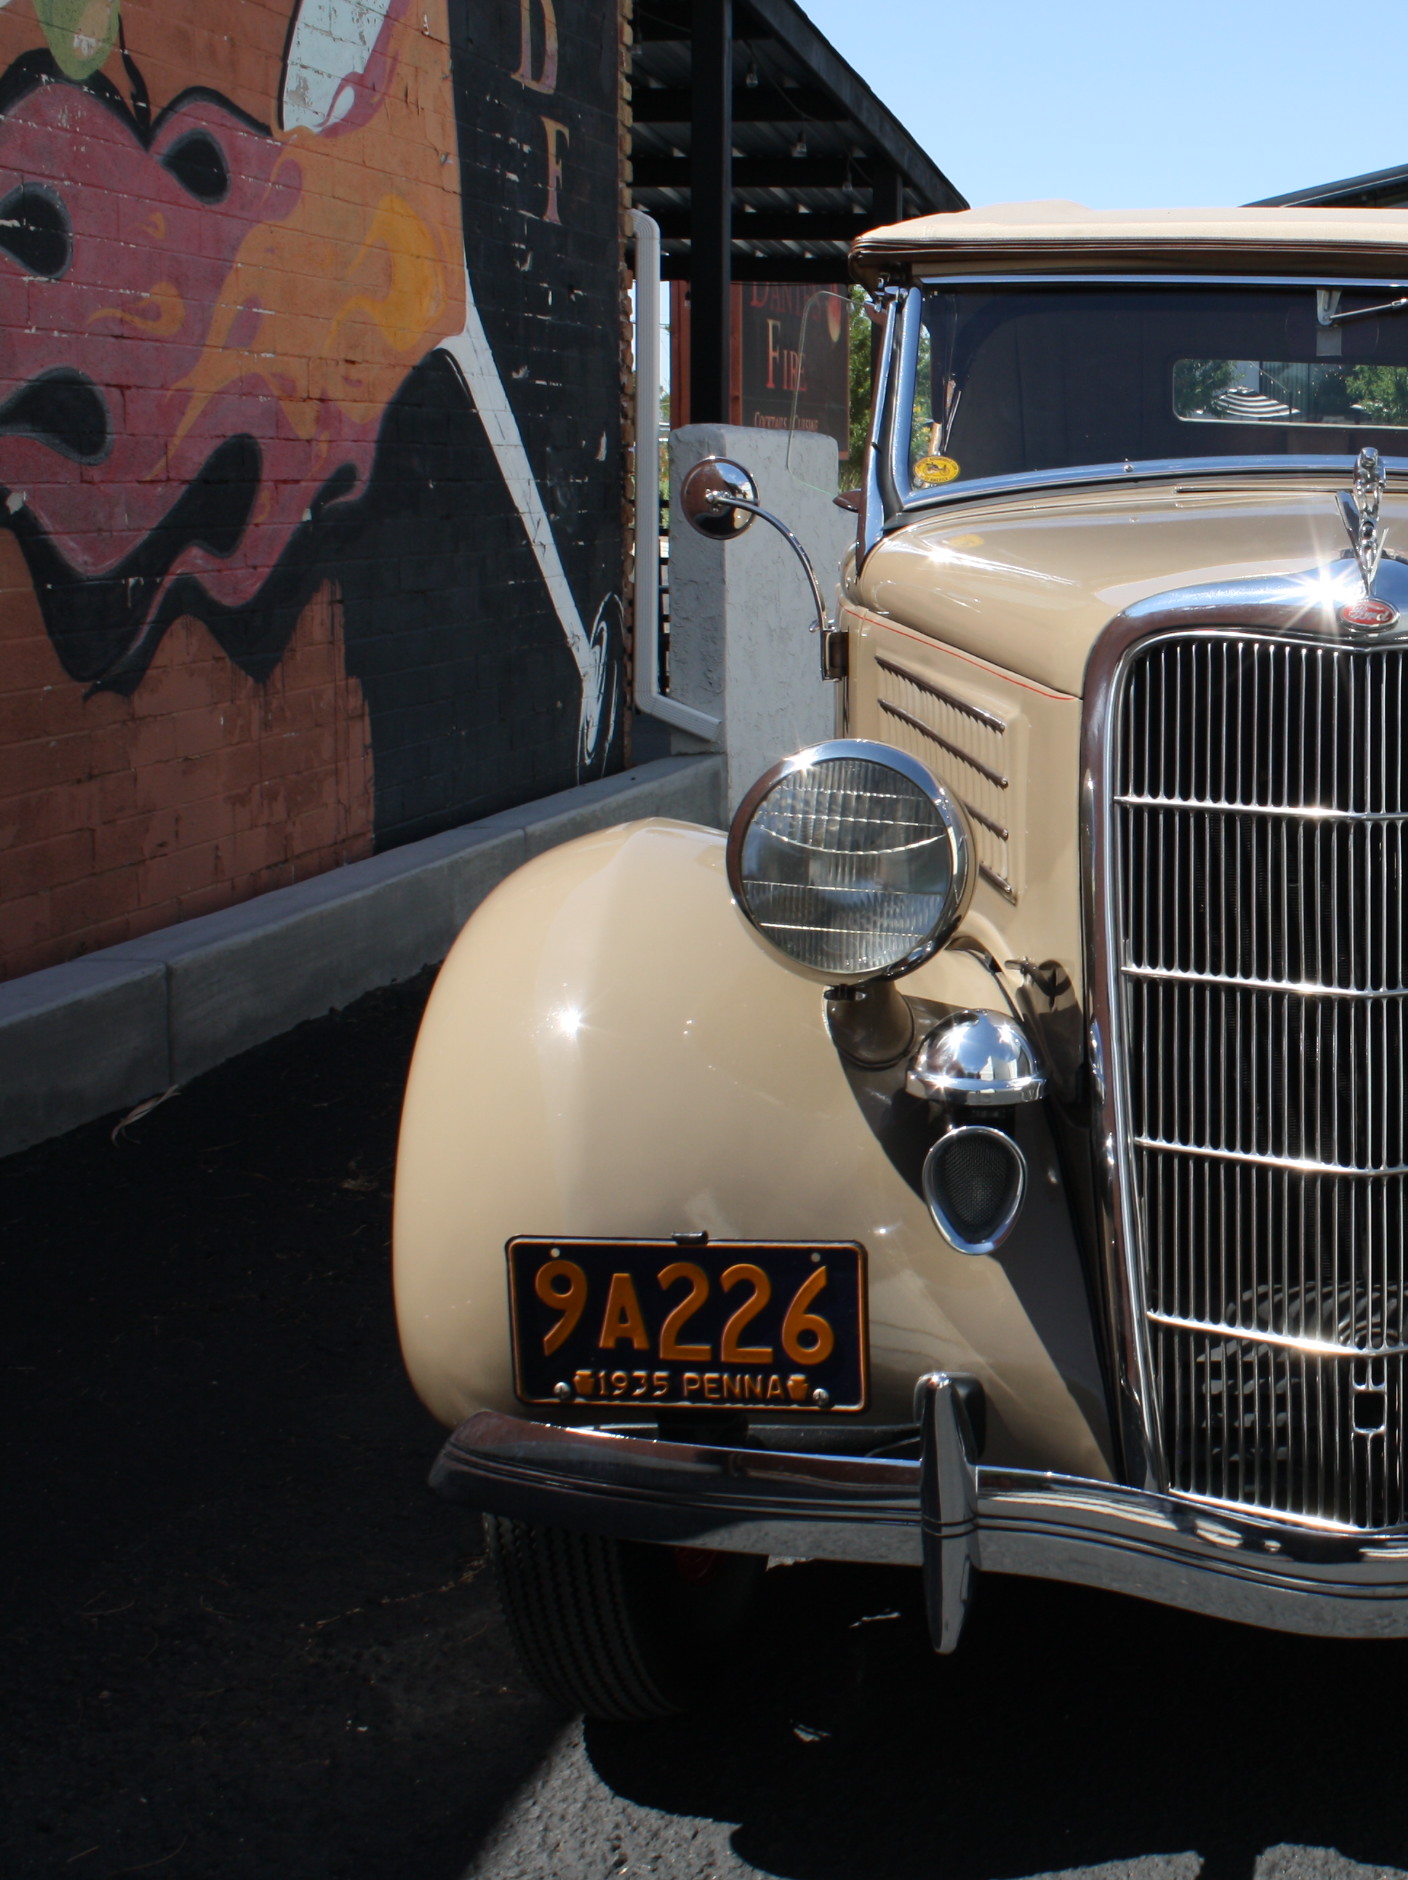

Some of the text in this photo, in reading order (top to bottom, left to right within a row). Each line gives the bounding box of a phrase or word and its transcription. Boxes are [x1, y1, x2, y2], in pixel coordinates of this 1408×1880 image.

[540, 115, 570, 225] F
[1348, 603, 1390, 621] Ford
[534, 1259, 835, 1366] 9A226
[597, 1369, 784, 1400] 1935 PENNA
